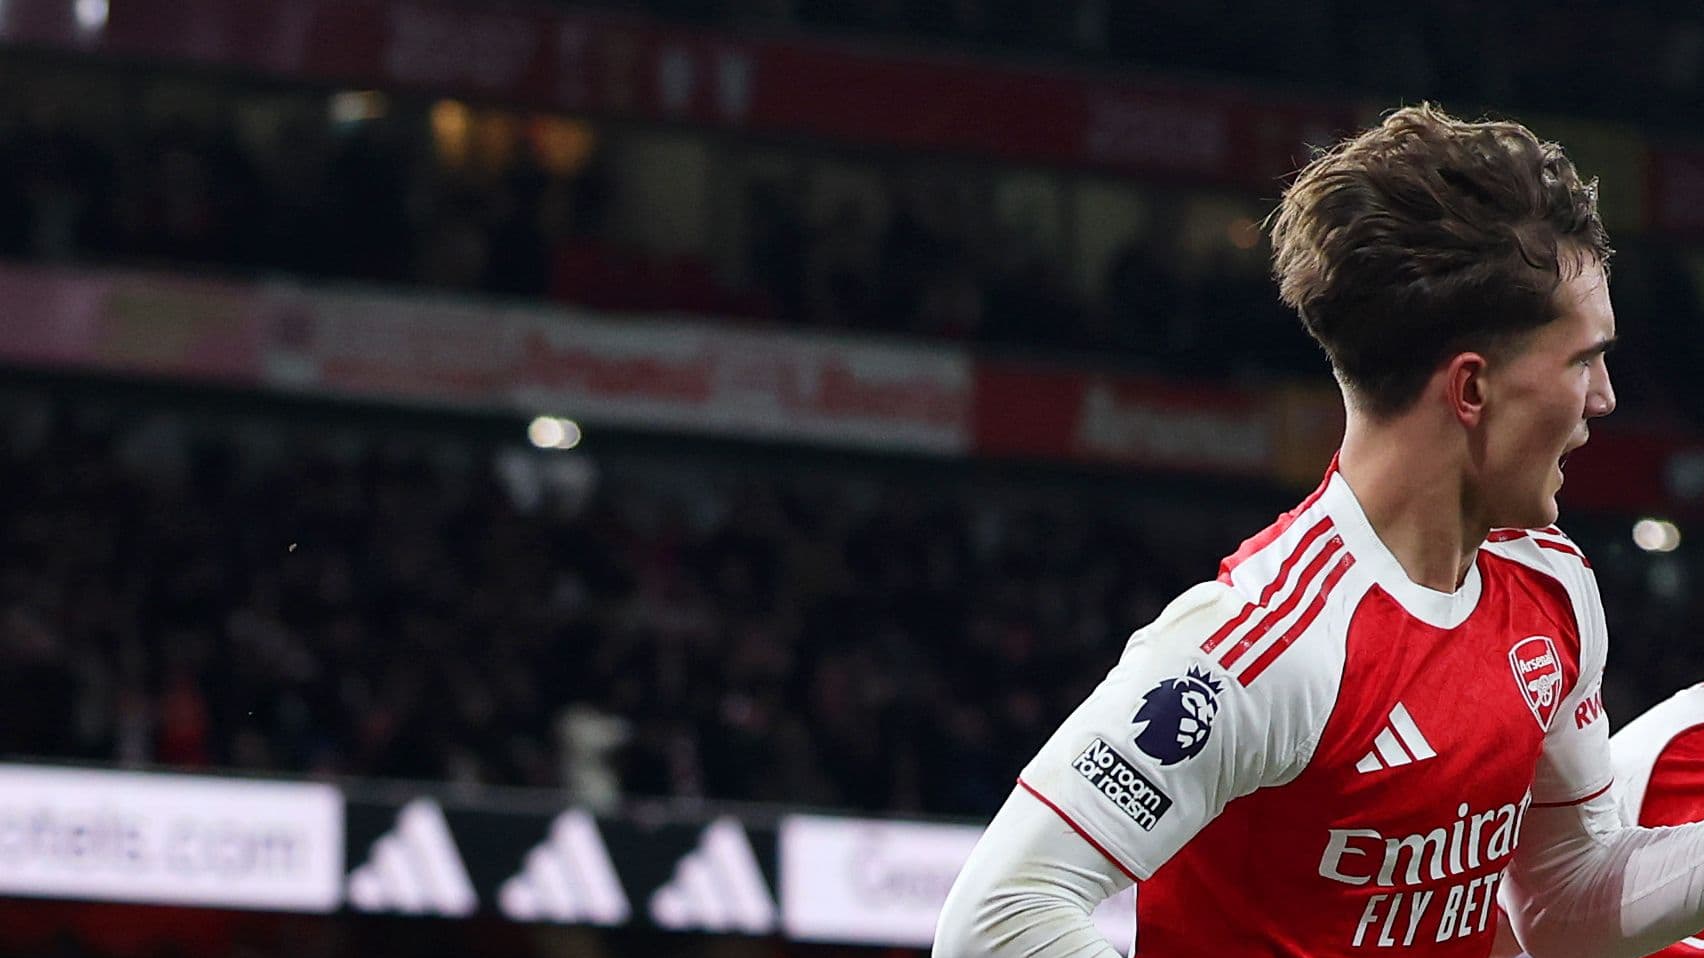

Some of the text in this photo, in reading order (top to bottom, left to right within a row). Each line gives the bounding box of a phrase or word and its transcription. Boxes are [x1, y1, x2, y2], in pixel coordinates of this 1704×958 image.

[1519, 649, 1553, 674] Arsenal
[1072, 752, 1157, 831] for racism
[1084, 739, 1162, 812] No room
[1351, 871, 1506, 948] FLY BET
